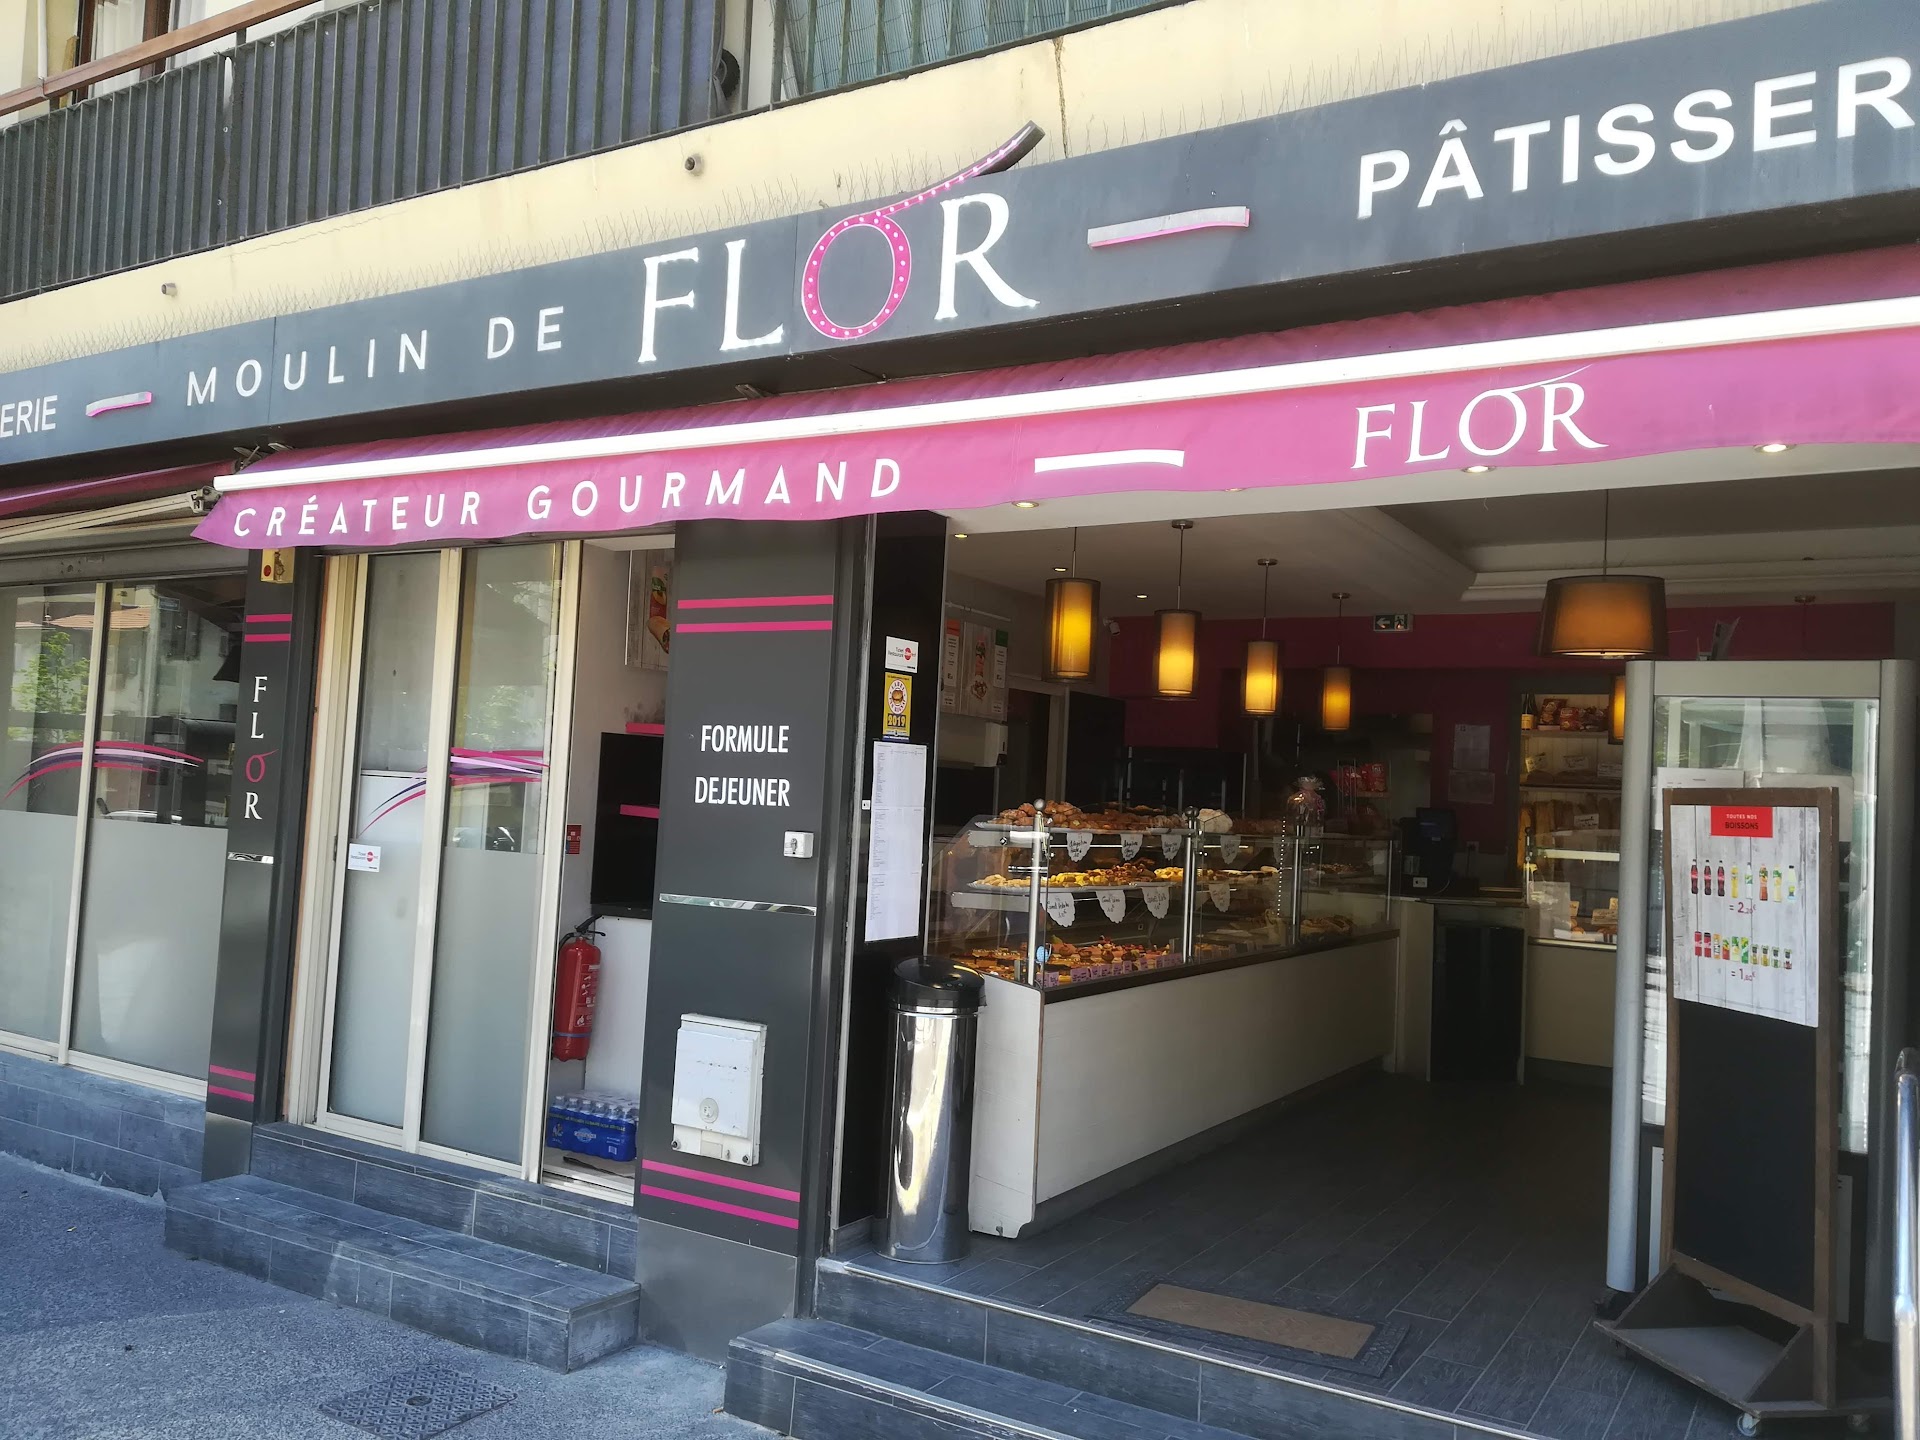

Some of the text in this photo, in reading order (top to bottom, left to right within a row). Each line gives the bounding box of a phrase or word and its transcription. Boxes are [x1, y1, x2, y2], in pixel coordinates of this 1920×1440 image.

[187, 329, 429, 407] MOULIN
[487, 306, 564, 360] DE
[637, 120, 1045, 364] FLOR
[1357, 55, 1916, 221] PÂTISSER
[1350, 364, 1610, 470] FLOR
[233, 457, 901, 537] CRÉATEUR GOURMAND
[244, 675, 279, 820] FLOR
[700, 724, 790, 754] FORMULE
[887, 714, 906, 727] 2019
[694, 776, 791, 808] DEJEUNER
[1725, 821, 1759, 830] BOISSONS
